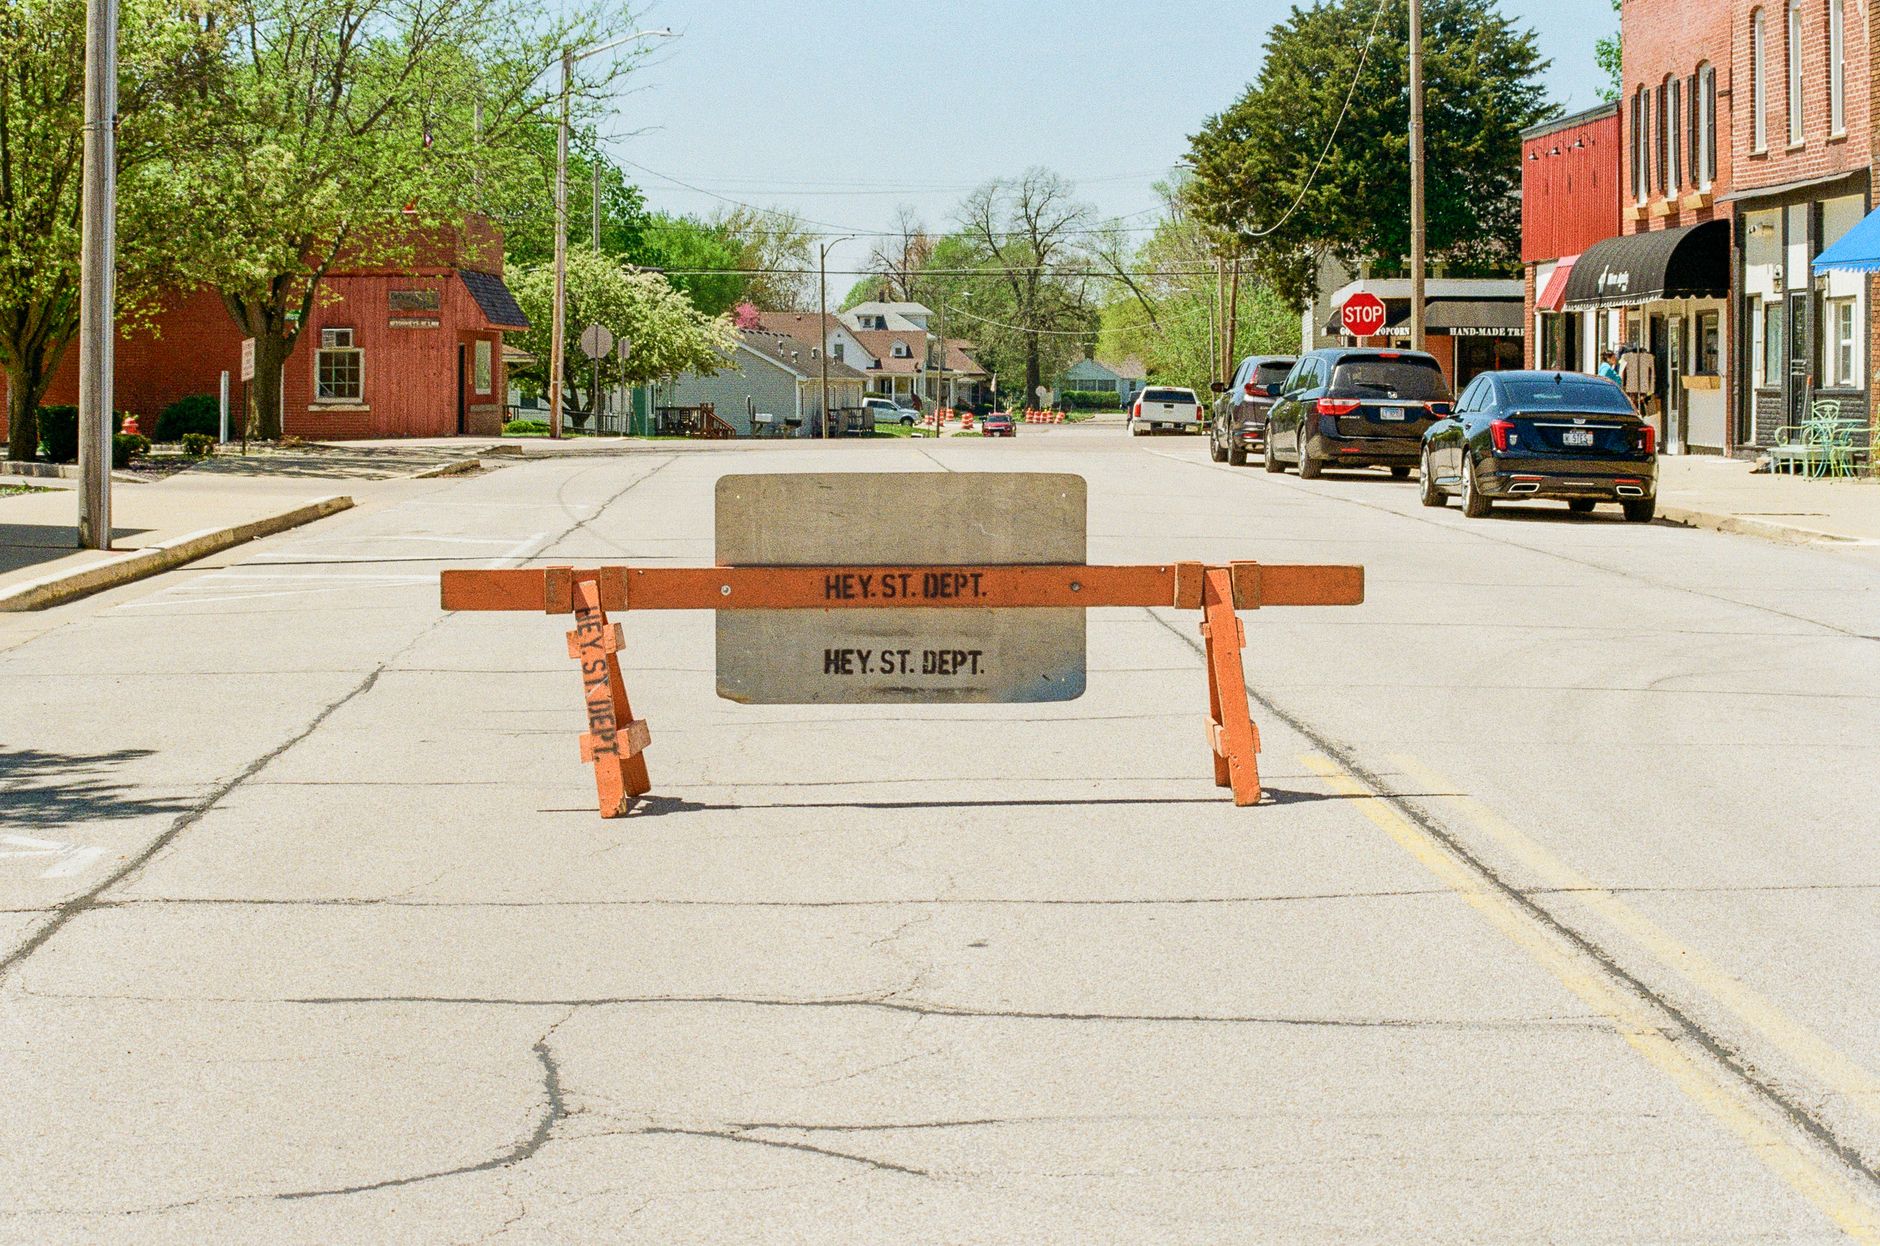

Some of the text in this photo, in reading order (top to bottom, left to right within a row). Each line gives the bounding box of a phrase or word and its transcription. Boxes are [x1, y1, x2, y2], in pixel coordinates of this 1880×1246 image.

[1345, 305, 1383, 323] STOP
[1450, 327, 1506, 336] HAND-MADE
[824, 572, 988, 600] HEY. ST. DEPT.
[575, 605, 603, 656] HEY.
[823, 648, 985, 675] HEY. ST. DEPT.
[588, 696, 620, 762] DEPT.
